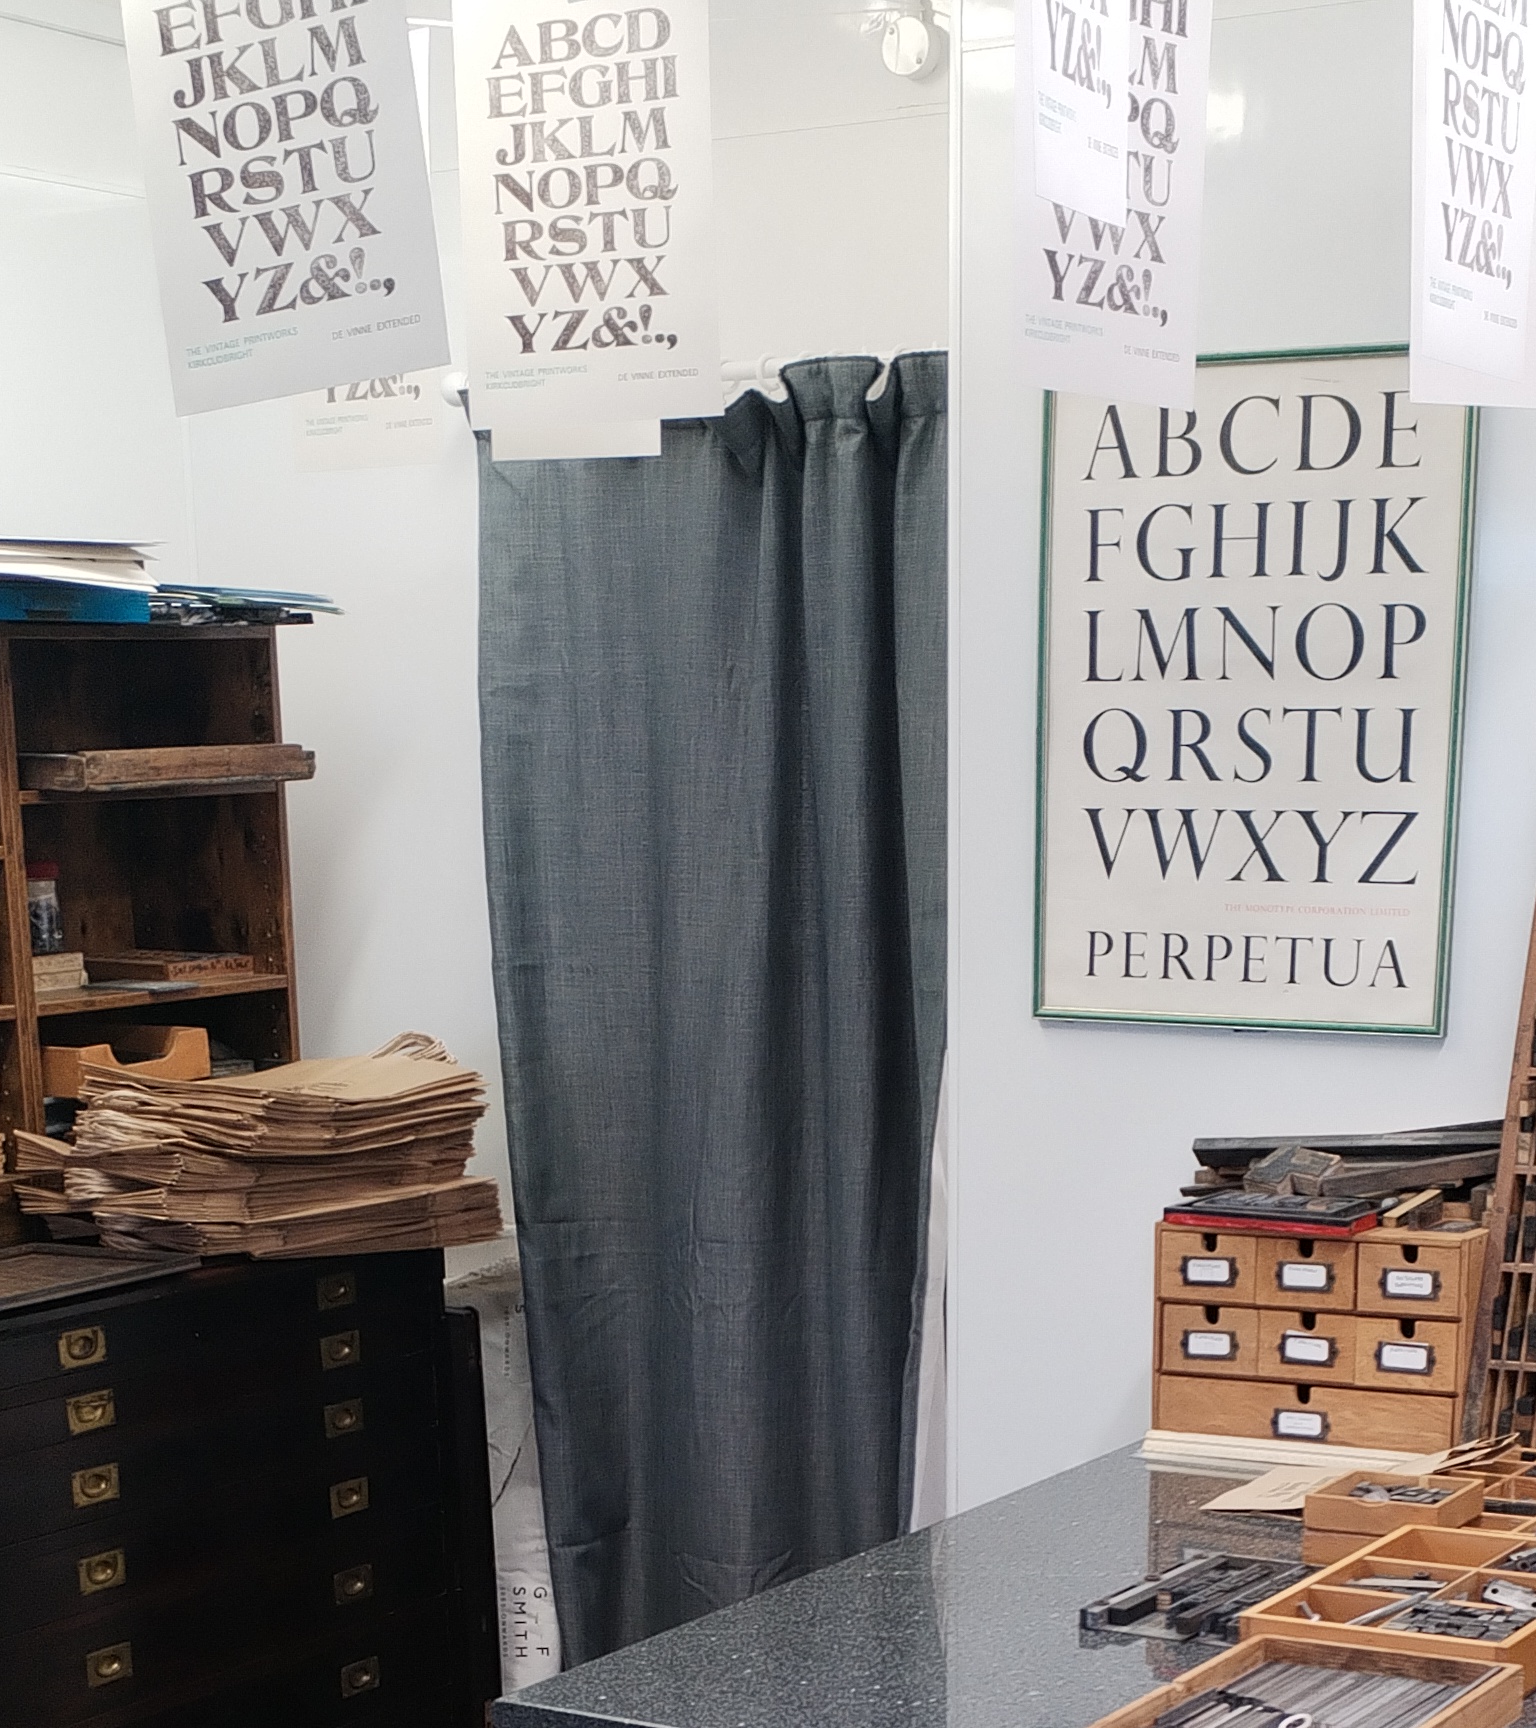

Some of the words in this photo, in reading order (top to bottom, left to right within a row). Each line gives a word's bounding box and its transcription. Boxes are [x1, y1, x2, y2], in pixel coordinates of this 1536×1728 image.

[173, 15, 367, 109] JKLM
[491, 7, 670, 70] ABCD
[1442, 0, 1526, 95] NOPQ
[172, 76, 379, 166] NOPQ
[485, 55, 680, 119] EFGHI
[1442, 67, 1520, 155] RSTU
[187, 130, 378, 219] RSTU
[495, 106, 672, 166] JKLM
[492, 157, 679, 215] NOPQ
[1445, 136, 1514, 219] VWX
[201, 187, 382, 268] VWX
[501, 205, 672, 262] RSTU
[509, 255, 670, 307] VWX
[1081, 390, 1422, 481] ABCDE
[1084, 495, 1429, 583] FGHIJK
[1084, 602, 1426, 683] LMNOP
[1081, 706, 1419, 784] QRSTU
[1081, 807, 1419, 886] VWXYZ
[1298, 905, 1366, 915] CORPORATION
[1370, 907, 1410, 917] LIMITED
[1086, 930, 1409, 989] PERPETUA
[513, 1586, 527, 1658] SMITH
